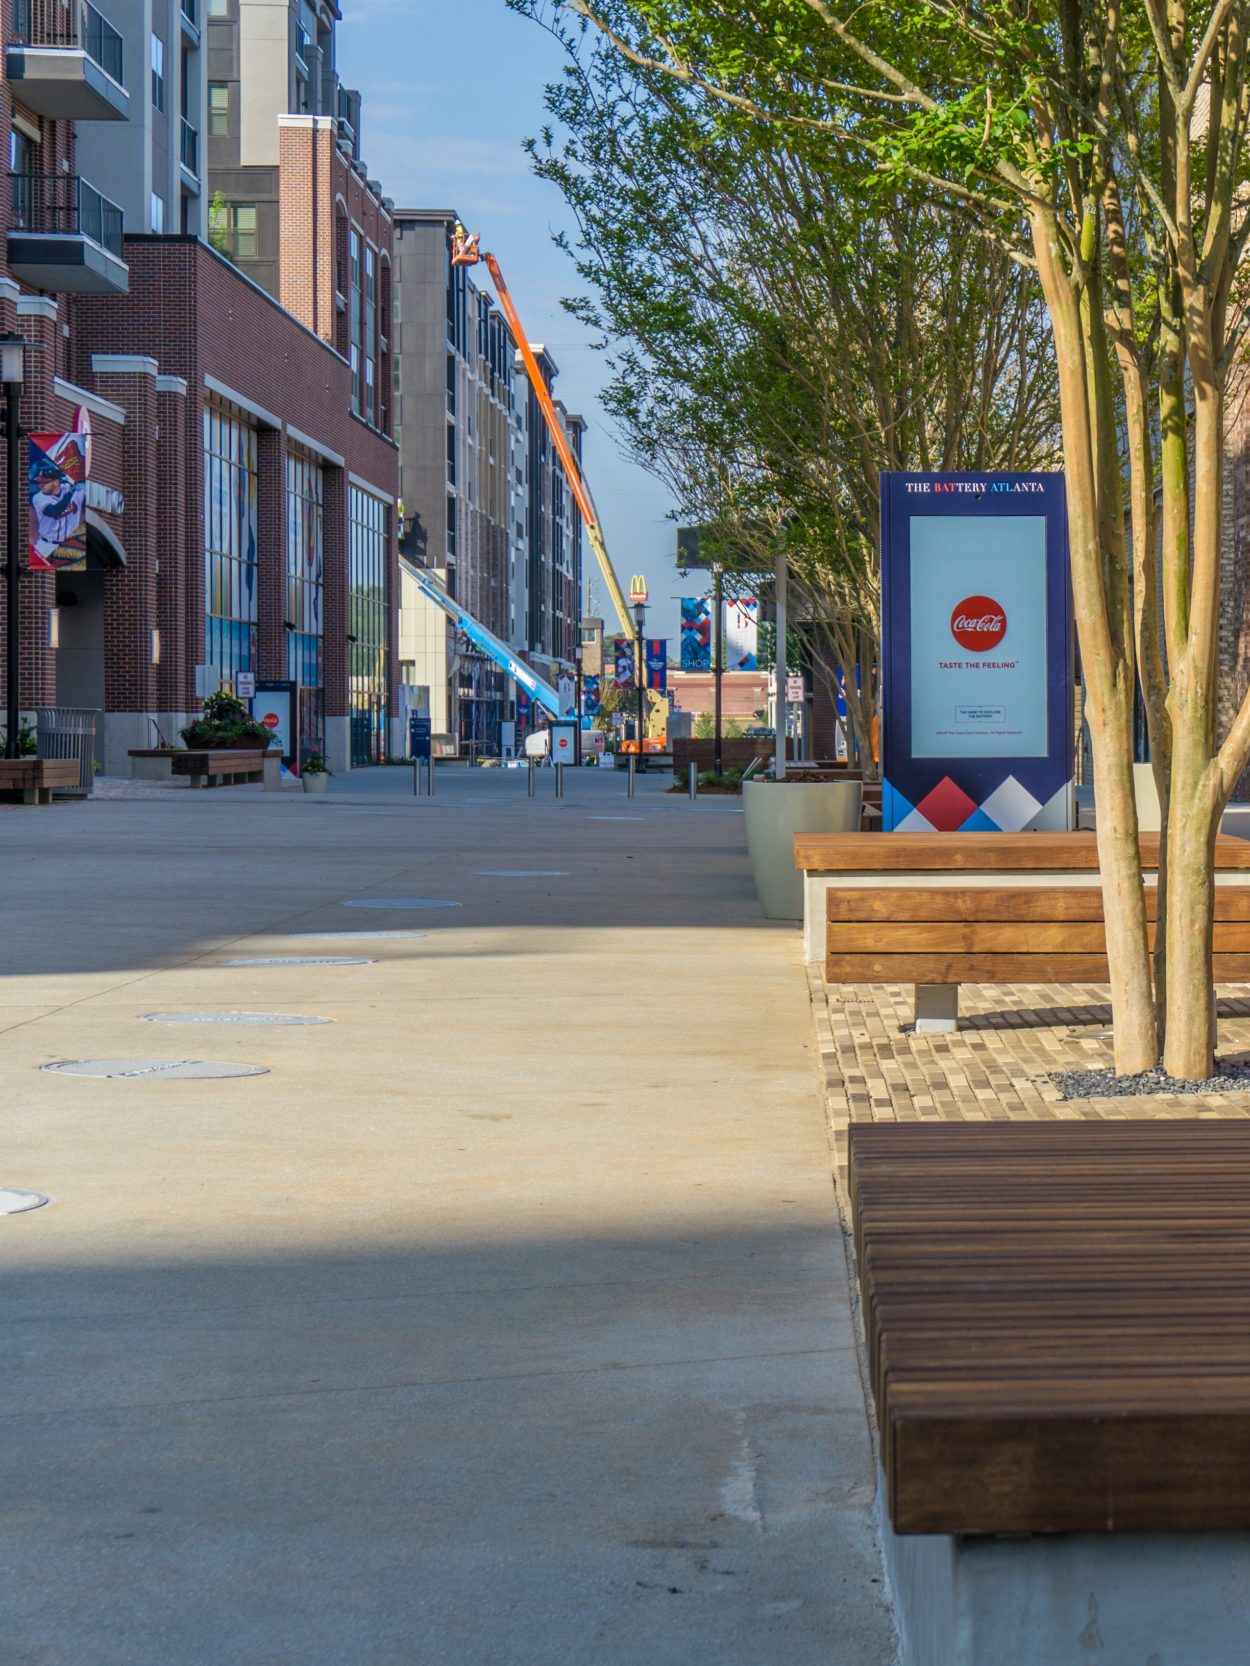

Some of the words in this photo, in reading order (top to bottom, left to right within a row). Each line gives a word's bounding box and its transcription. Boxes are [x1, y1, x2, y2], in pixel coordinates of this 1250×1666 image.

[905, 482, 931, 493] THE
[934, 482, 988, 493] BATTERY
[990, 482, 1045, 493] ATLANTA
[953, 614, 1004, 632] Coca-Cola
[682, 659, 710, 668] SHOP
